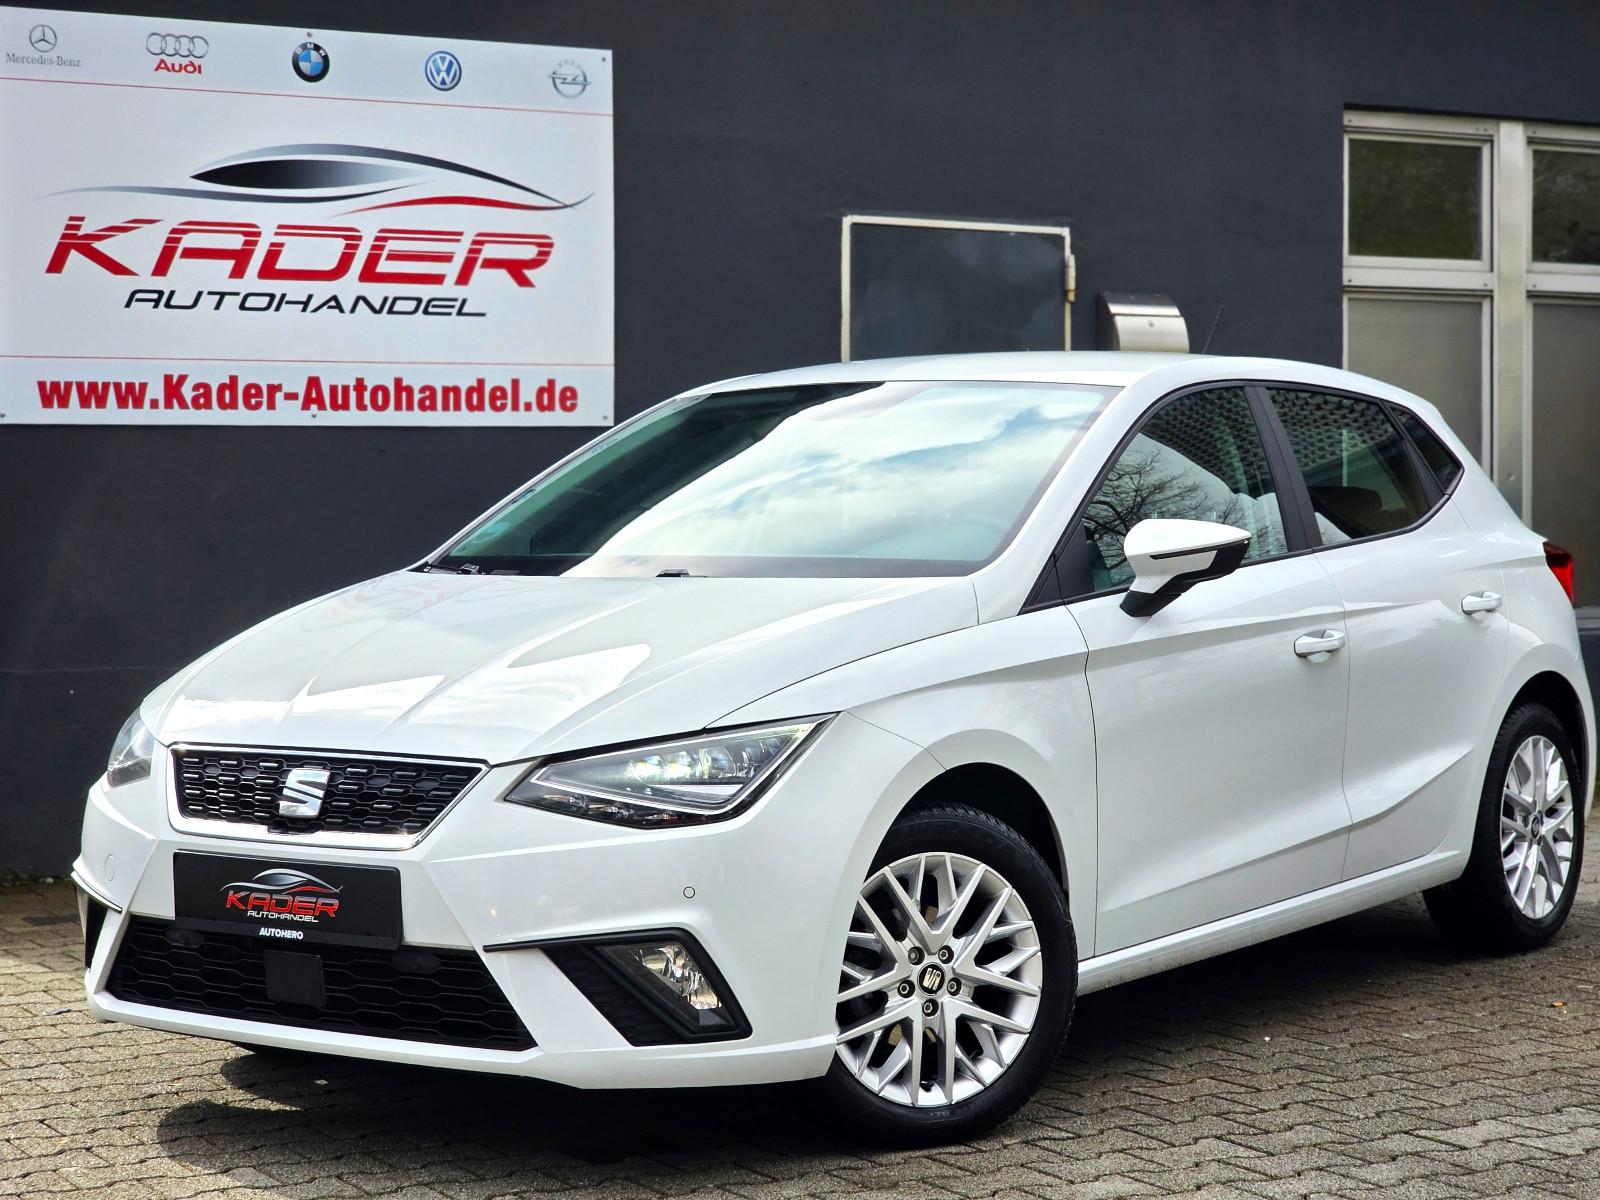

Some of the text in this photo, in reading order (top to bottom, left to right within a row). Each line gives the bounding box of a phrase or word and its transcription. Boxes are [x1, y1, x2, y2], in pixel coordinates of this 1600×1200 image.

[154, 59, 202, 74] Audi
[45, 216, 554, 288] KADER
[124, 289, 487, 317] AUTOHANDEL
[37, 374, 578, 412] www.Kader-Autohandel.de
[225, 890, 339, 918] KADER
[247, 910, 319, 923] AUTOHANDEL
[258, 927, 304, 940] AUTOHERO
